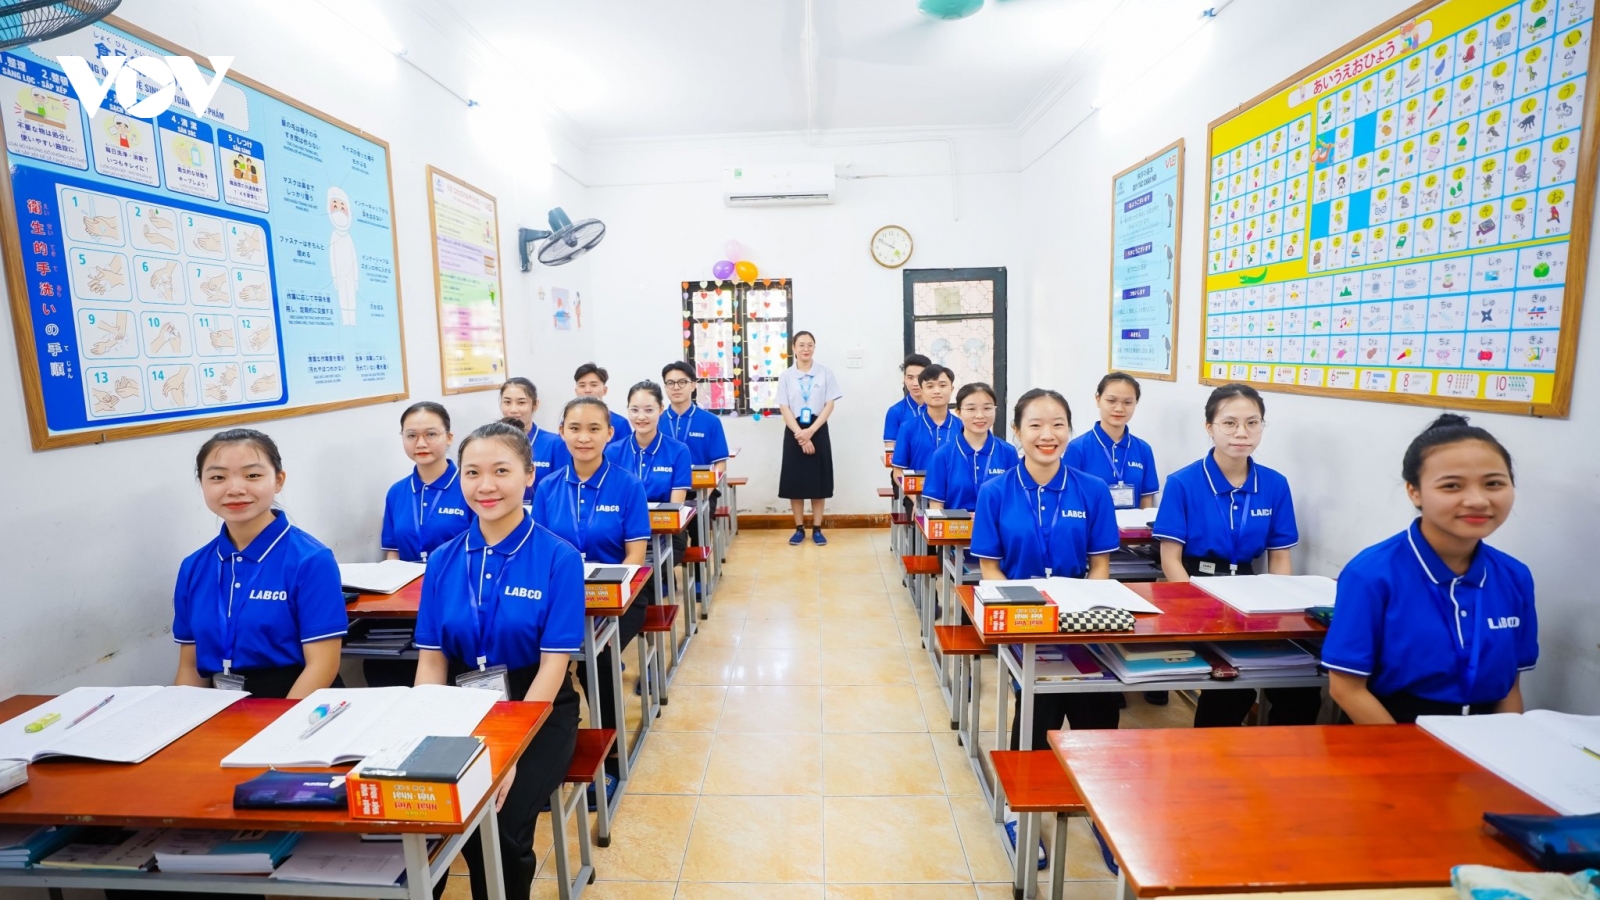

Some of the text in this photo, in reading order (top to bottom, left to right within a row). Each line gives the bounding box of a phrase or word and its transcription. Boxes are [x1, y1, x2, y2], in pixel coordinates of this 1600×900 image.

[1567, 30, 1582, 44] い
[1313, 41, 1396, 94] あいうえおひょう
[72, 196, 78, 208] 1
[135, 206, 141, 217] 2
[188, 217, 194, 227] 3
[1424, 219, 1432, 228] の
[231, 226, 237, 236] 4
[78, 254, 86, 265] 5
[1536, 250, 1552, 259] きゃ
[142, 261, 149, 272] 6
[196, 269, 201, 278] 7
[237, 272, 243, 281] 8
[1532, 294, 1546, 303] きゅ
[88, 314, 95, 324] 9
[148, 317, 160, 328] 10
[199, 318, 209, 328] 11
[242, 319, 251, 328] 12
[1480, 337, 1493, 345] しょ
[1529, 335, 1543, 345] きょ
[203, 367, 214, 378] 15
[247, 364, 257, 374] 16
[1303, 369, 1308, 380] 5
[94, 372, 108, 383] 13
[152, 370, 164, 381] 14
[1331, 369, 1336, 381] 6
[1366, 372, 1371, 384] 7
[1403, 374, 1410, 387] 8
[1446, 374, 1453, 388] 9
[1496, 376, 1507, 390] 10
[438, 507, 464, 516] LABCO
[249, 589, 287, 601] LABCO
[504, 586, 542, 600] LABCO
